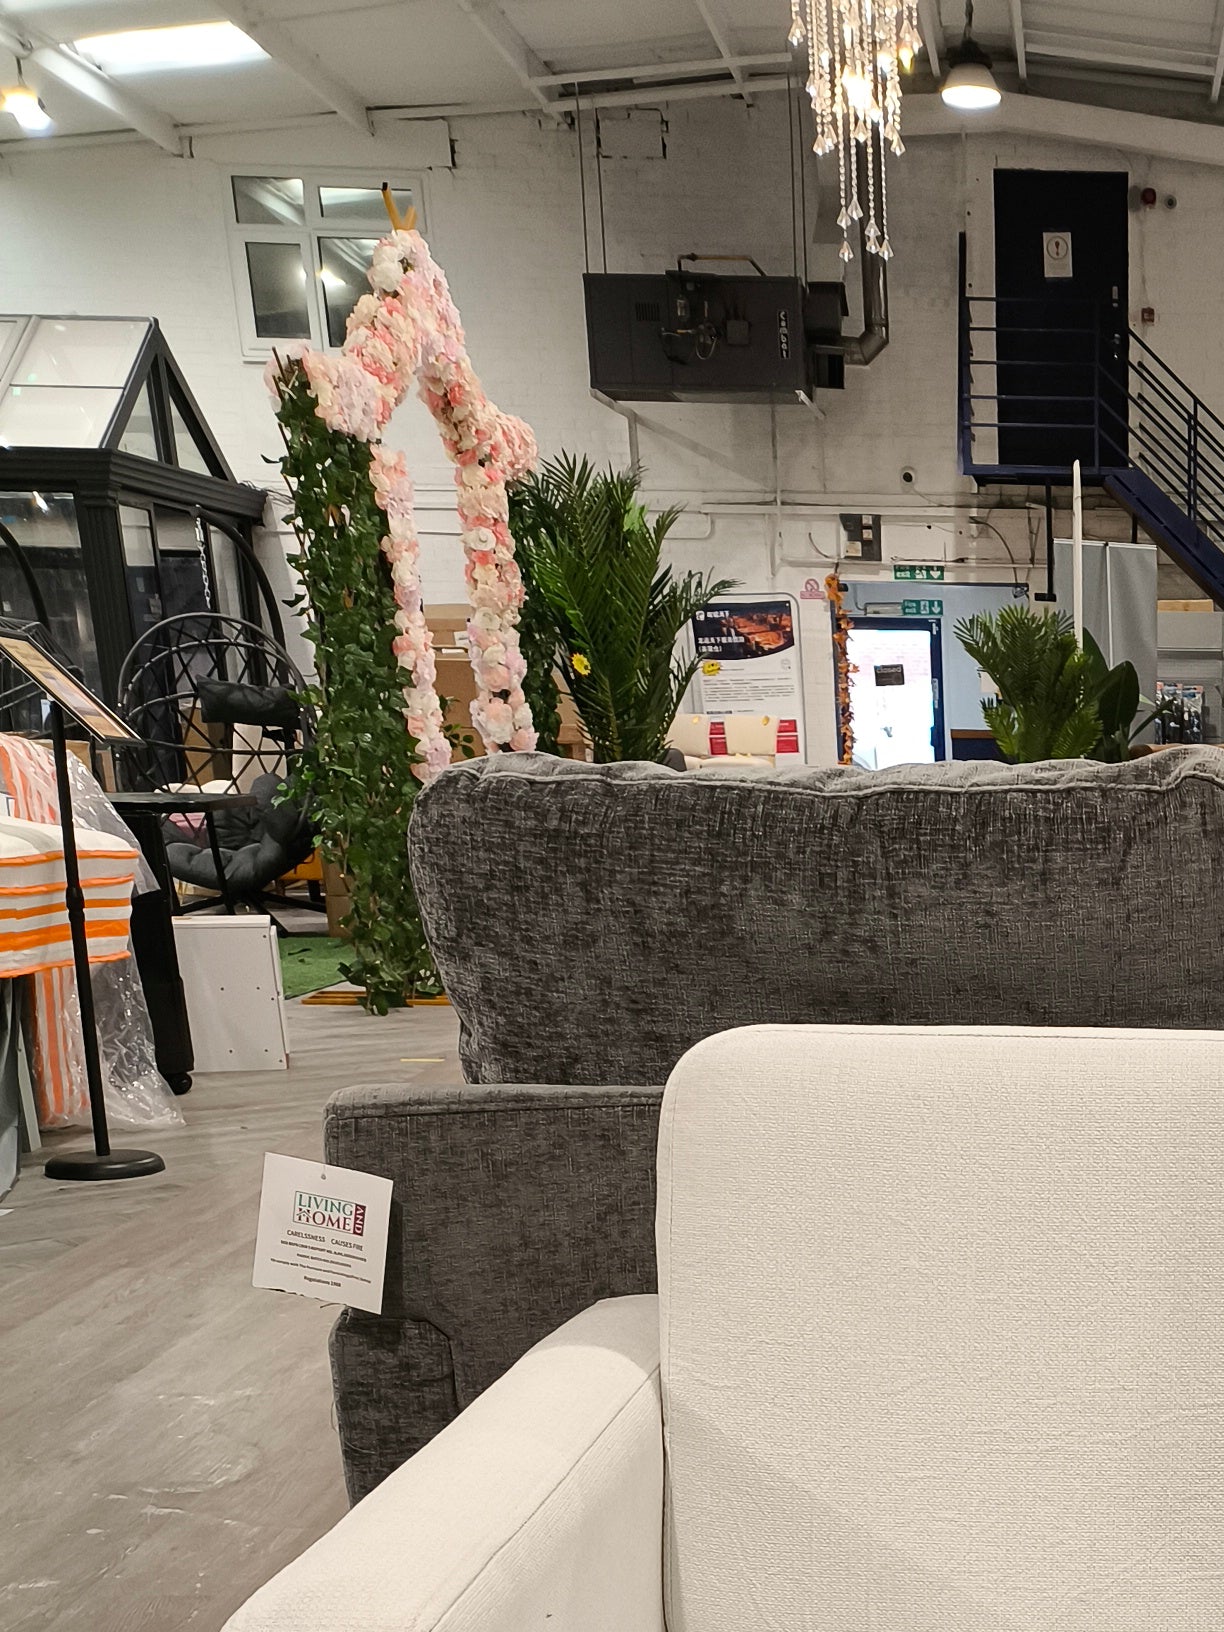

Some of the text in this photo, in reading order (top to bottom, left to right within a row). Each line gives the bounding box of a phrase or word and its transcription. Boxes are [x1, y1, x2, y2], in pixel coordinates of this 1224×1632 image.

[299, 1193, 353, 1217] LIVING
[296, 1207, 352, 1232] HOME
[354, 1205, 365, 1234] AND
